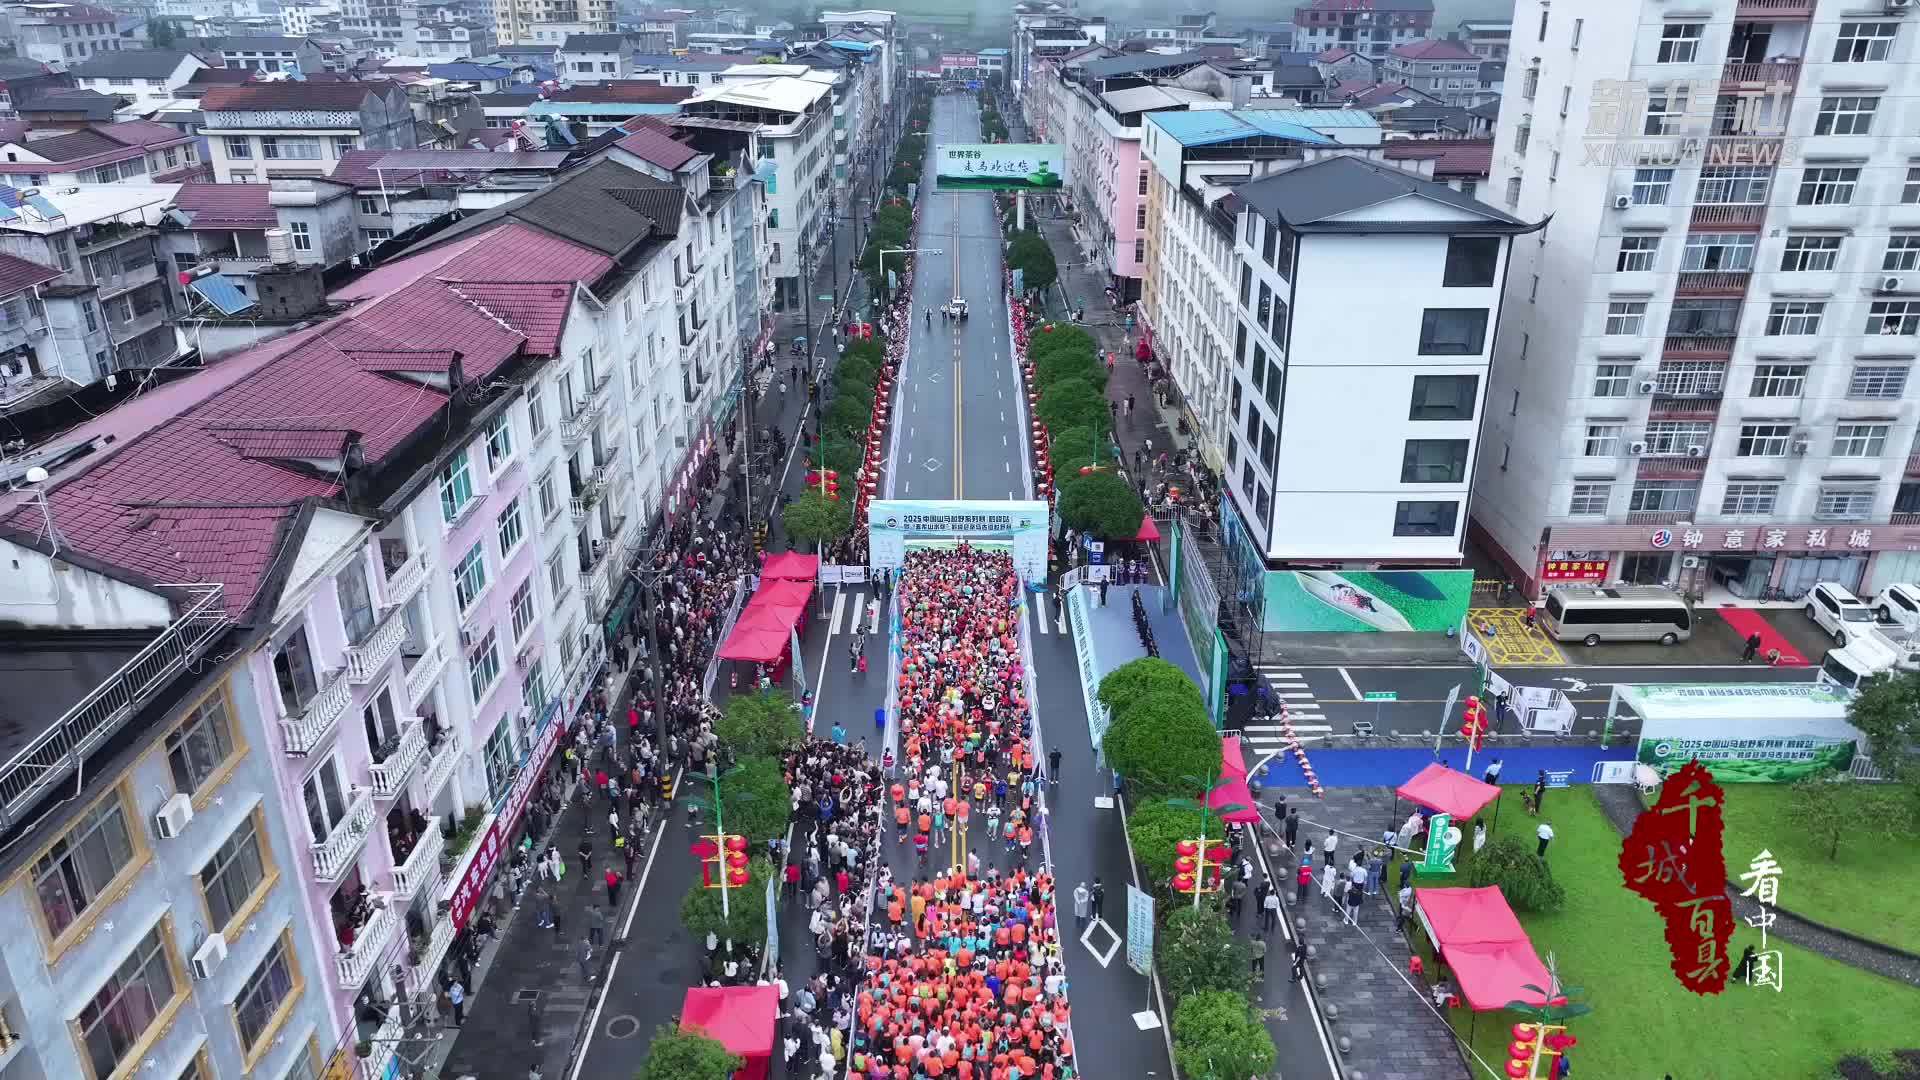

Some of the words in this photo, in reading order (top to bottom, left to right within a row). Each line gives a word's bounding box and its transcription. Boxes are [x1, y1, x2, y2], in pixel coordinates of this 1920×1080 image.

[948, 149, 982, 159] 世界茶谷
[963, 160, 1029, 173] 走马欢迎您
[1681, 527, 1873, 549] 钟意家私城
